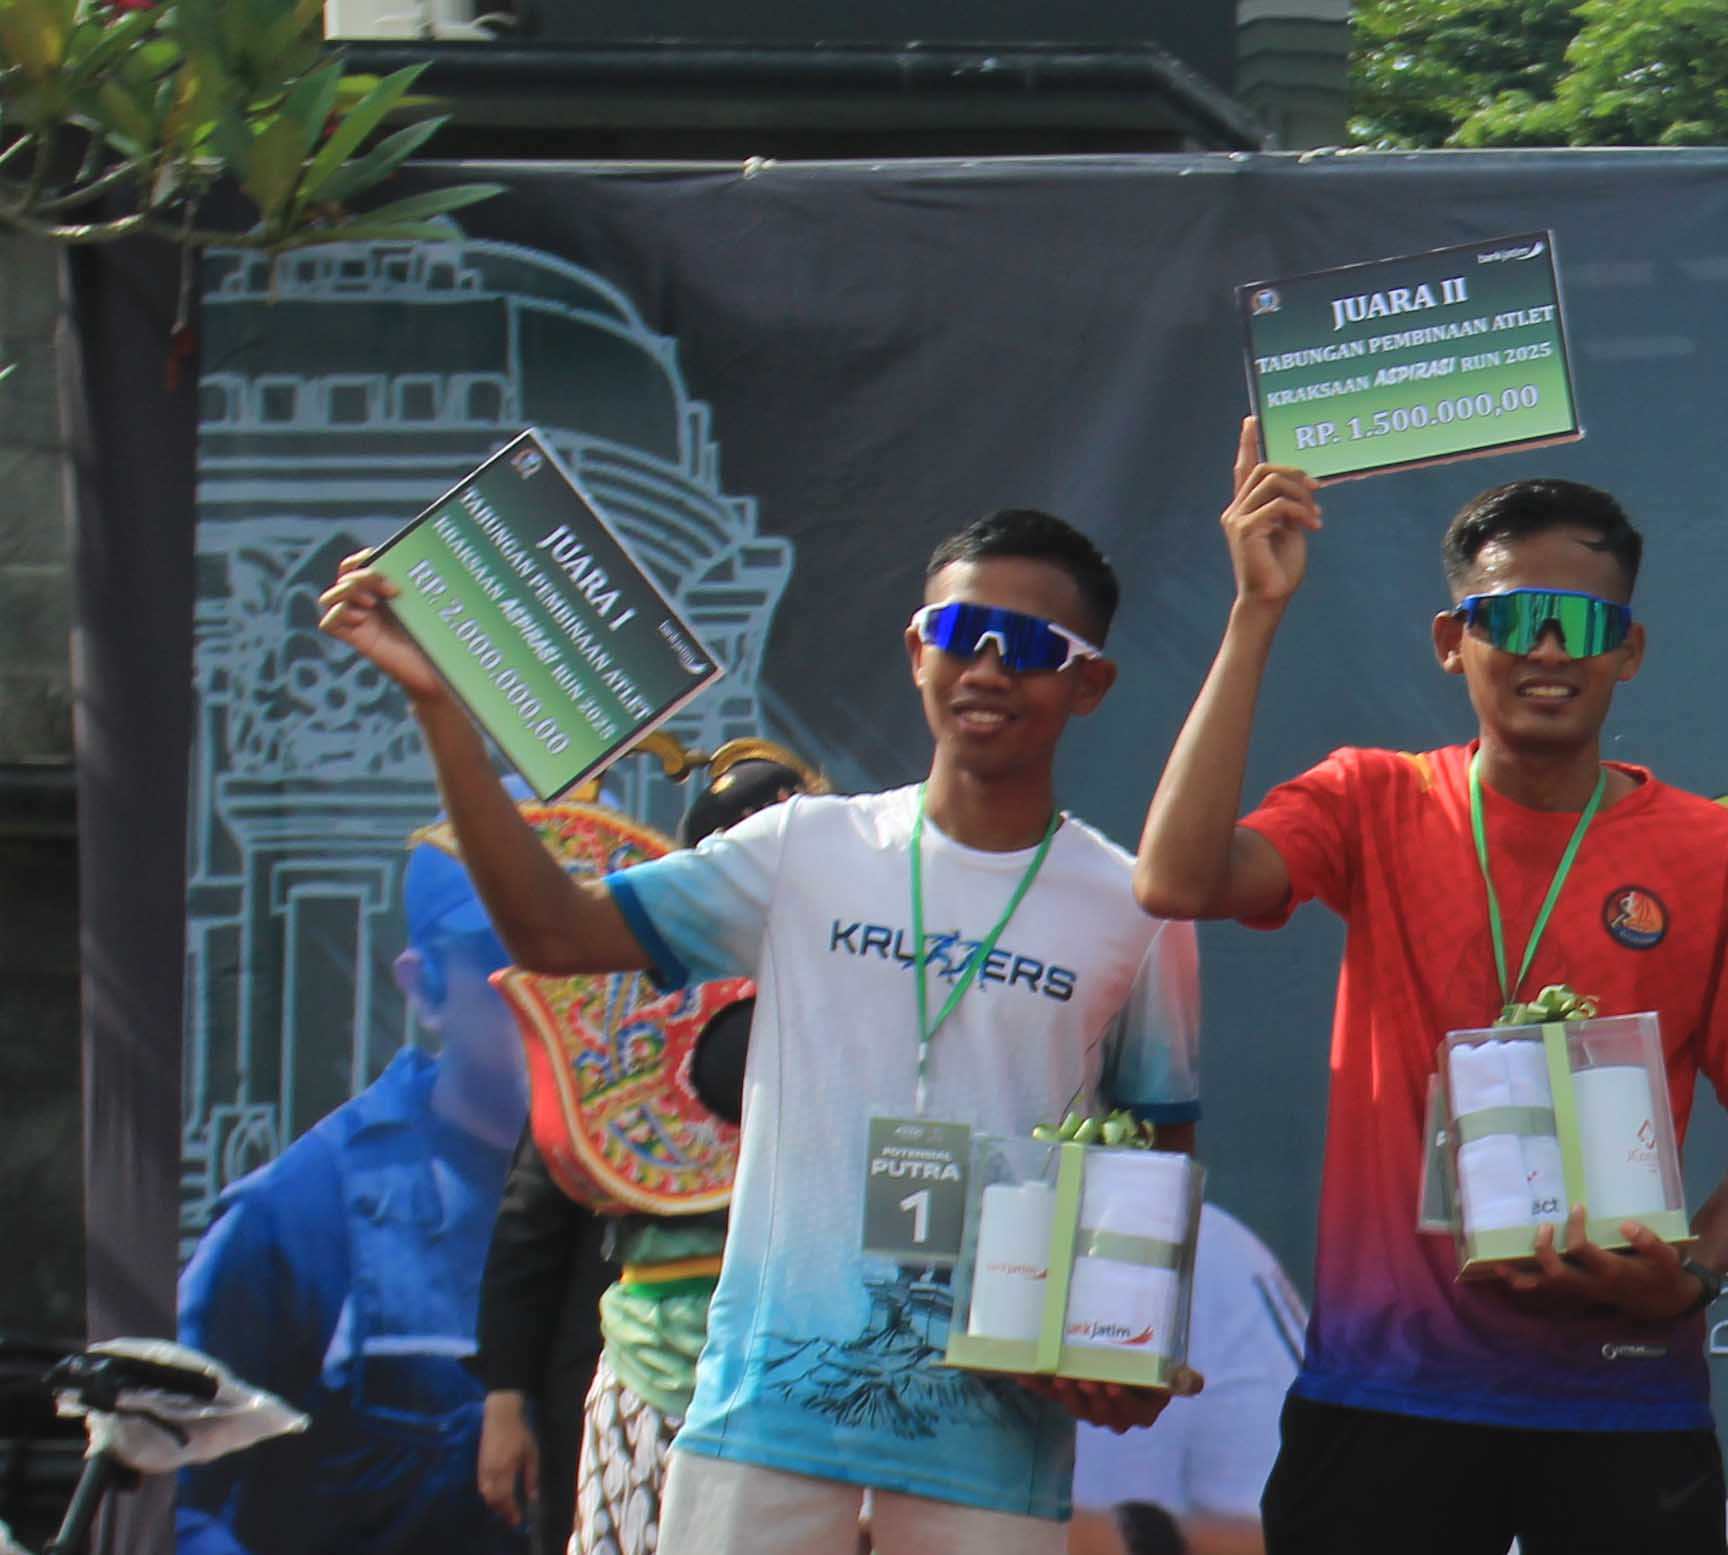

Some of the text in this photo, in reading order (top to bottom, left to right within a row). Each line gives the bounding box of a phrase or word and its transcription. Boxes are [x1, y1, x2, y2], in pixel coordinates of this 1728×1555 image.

[1330, 277, 1469, 331] JUARA II
[1255, 304, 1555, 374] TABUNGAN PEMBINAAN ATLET
[1267, 376, 1369, 408] KRAKSAAN
[1461, 352, 1501, 372] RUN
[1504, 342, 1552, 364] 2025
[1294, 384, 1540, 450] RP. 1.500.000,00
[433, 515, 503, 601] KRAKSAAN
[552, 658, 588, 700] RUN
[460, 485, 657, 721] TABUNGAN PEMBINAAN ATLET
[536, 525, 638, 632] JUARA I
[407, 559, 572, 756] RP. 2.000.000,00
[871, 1158, 960, 1182] PUTRA
[900, 1189, 929, 1243] 1
